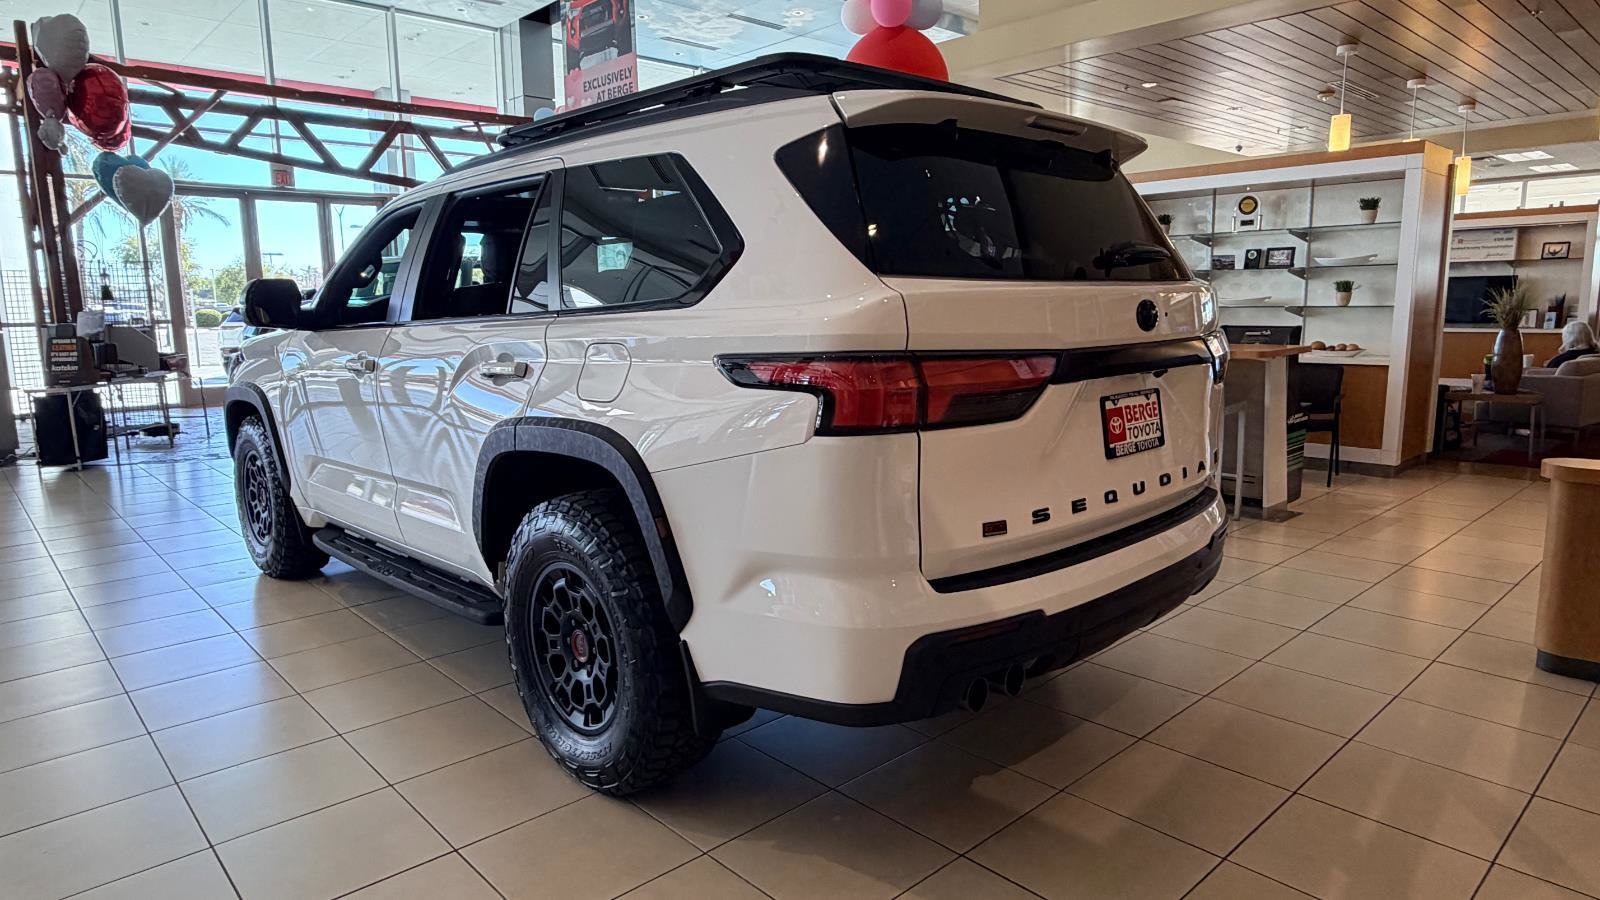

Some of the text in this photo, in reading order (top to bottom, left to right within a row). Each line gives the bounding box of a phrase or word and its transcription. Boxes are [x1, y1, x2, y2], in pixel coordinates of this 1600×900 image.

[583, 66, 633, 92] EXCLUSIVELY
[596, 82, 634, 102] AT BERGE
[1124, 401, 1158, 423] BERGE
[1127, 421, 1161, 440] TOYOTA
[1115, 438, 1160, 456] BERGE TOYOTA
[1031, 460, 1206, 525] SEQUOIA
